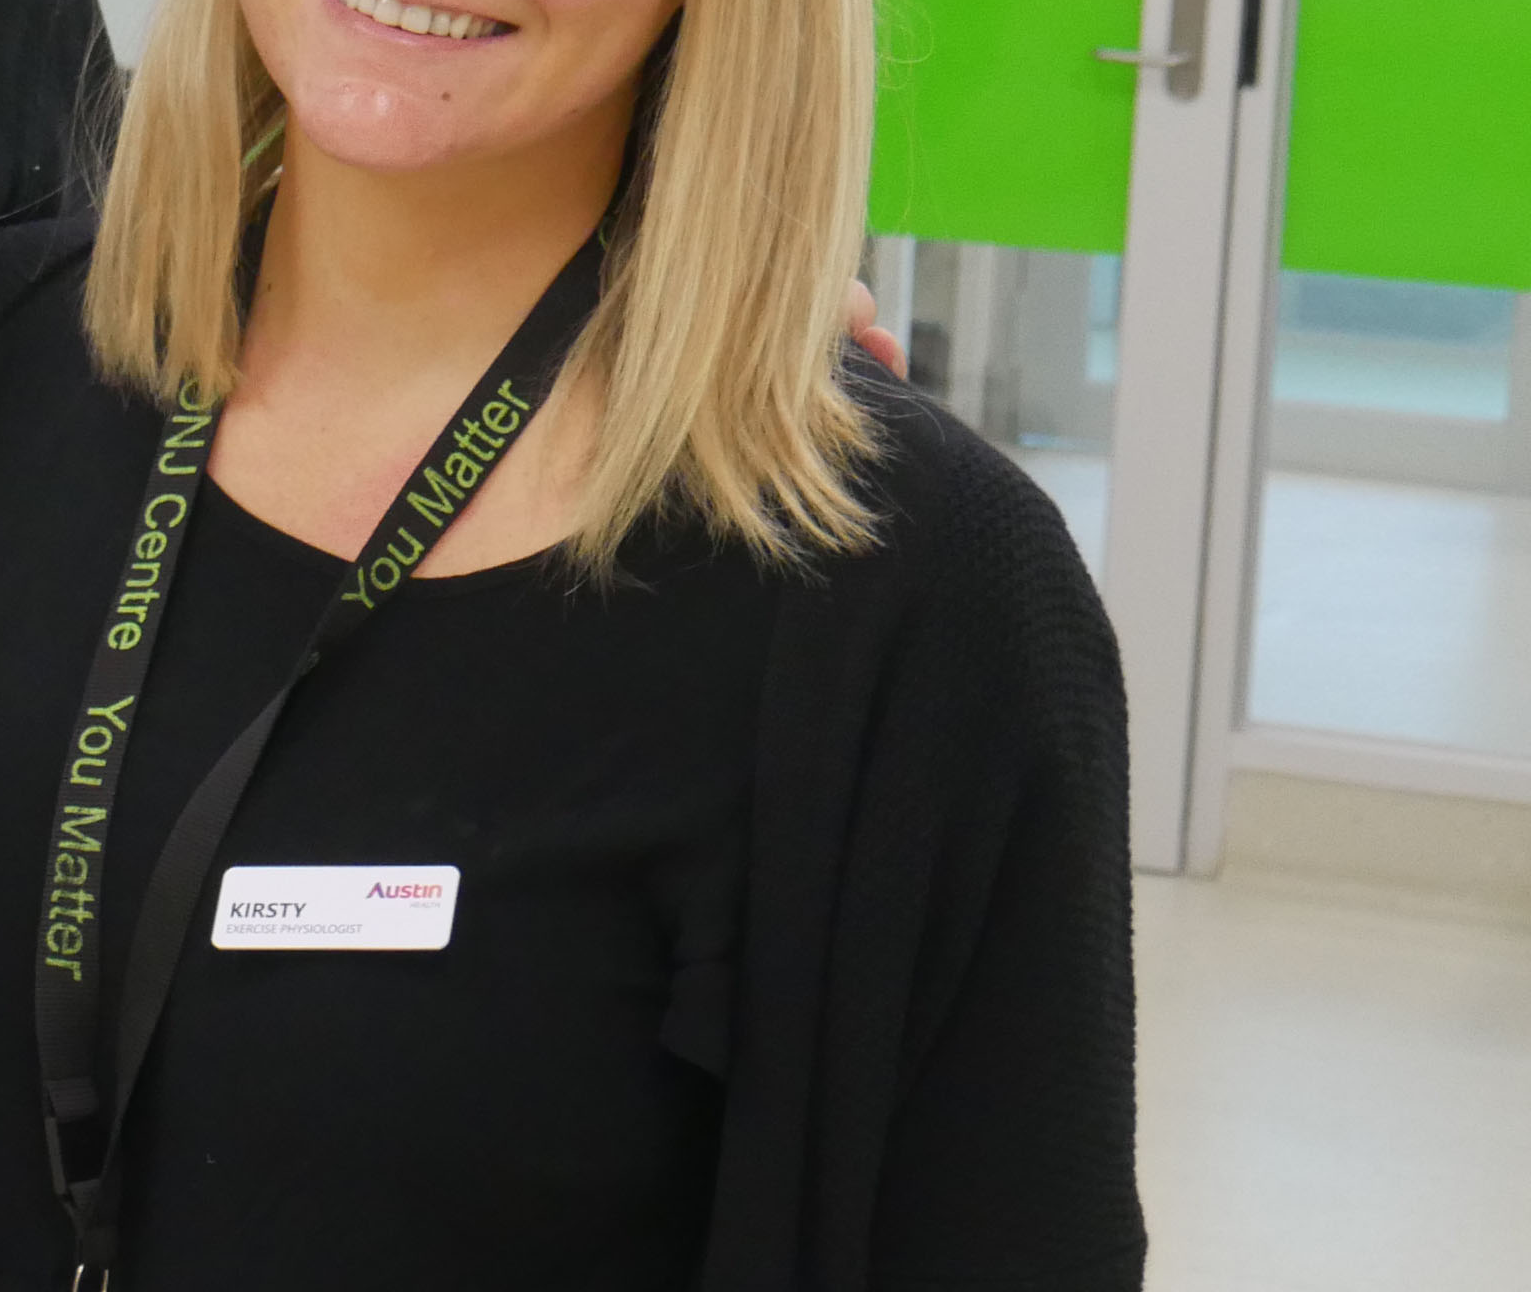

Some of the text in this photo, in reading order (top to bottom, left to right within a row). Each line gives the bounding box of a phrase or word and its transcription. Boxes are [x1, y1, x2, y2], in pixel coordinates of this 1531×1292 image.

[341, 379, 533, 611] You Matter
[107, 493, 188, 652] Centre
[69, 695, 135, 787] You
[44, 804, 108, 982] Matter
[226, 923, 363, 934] EXERCISE PHYSIOLOGIST
[229, 902, 307, 918] KIRSTY
[365, 881, 443, 899] Austin
